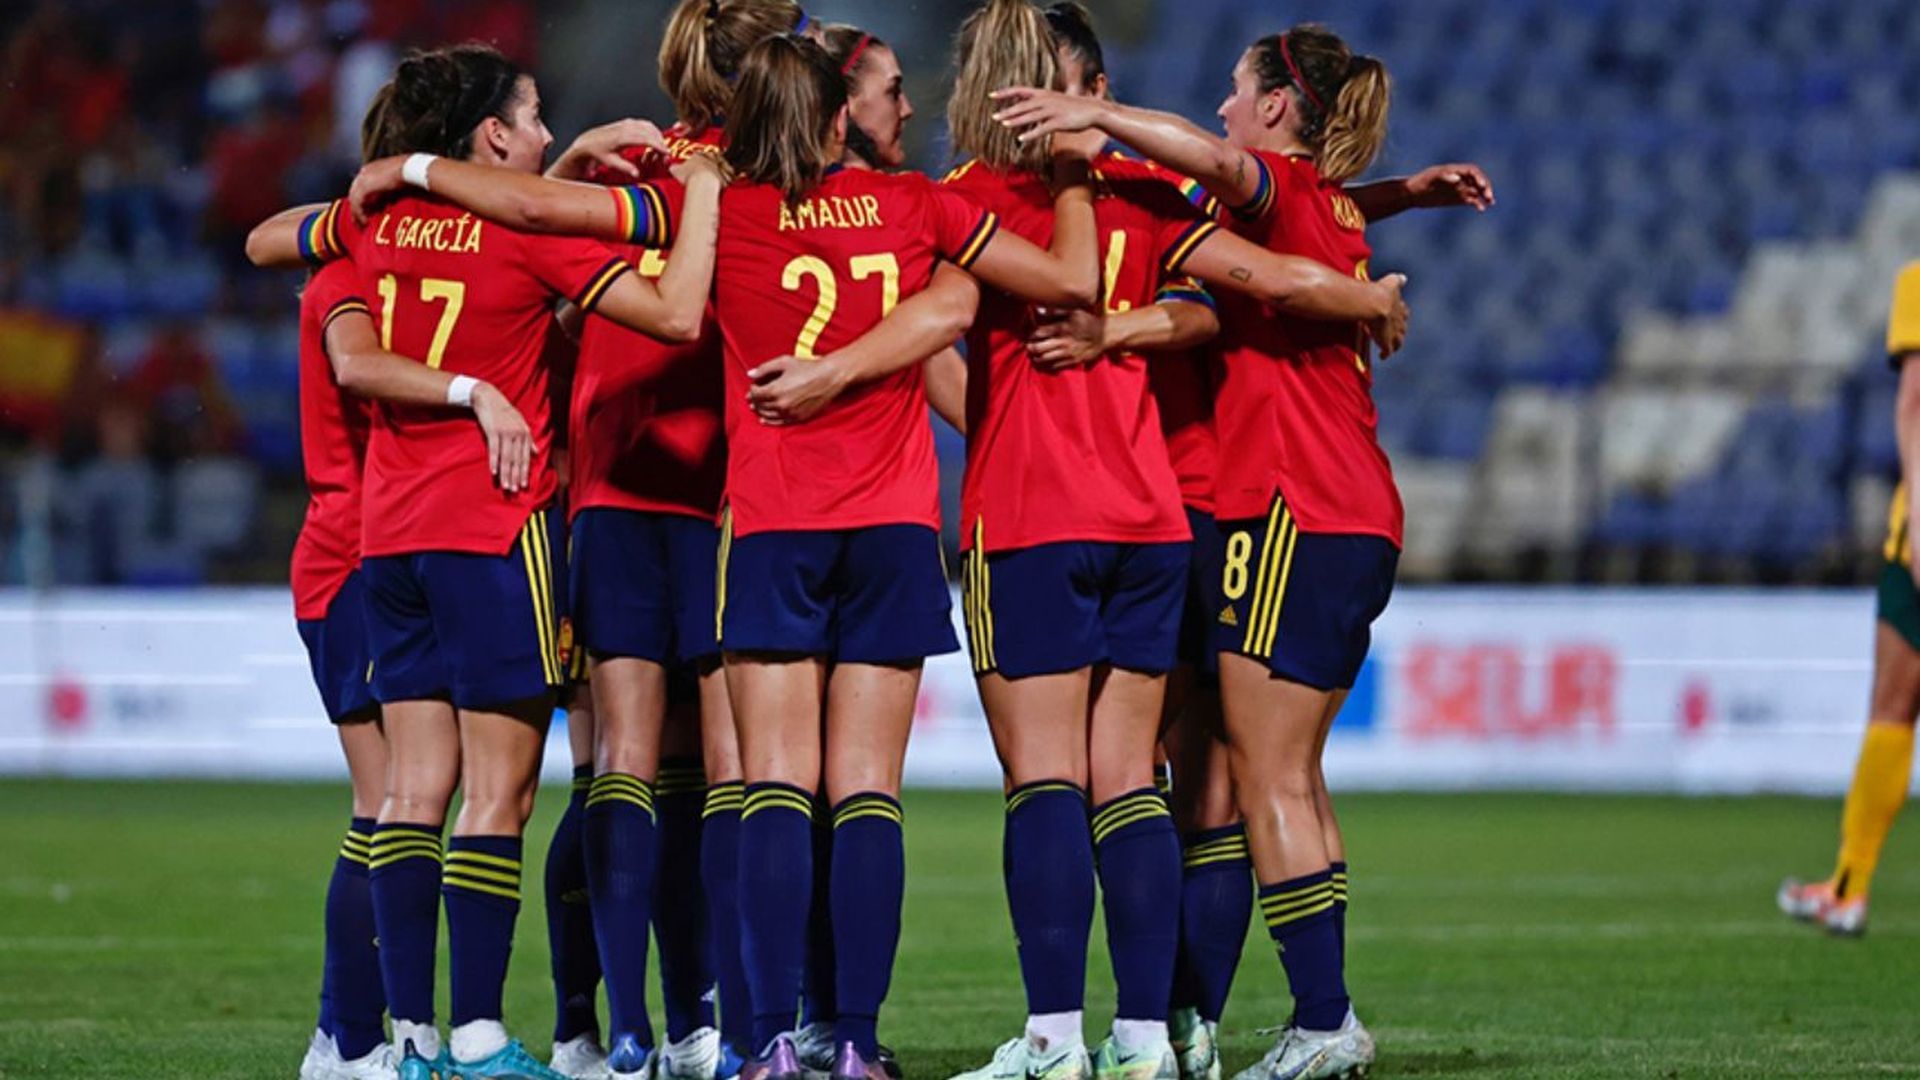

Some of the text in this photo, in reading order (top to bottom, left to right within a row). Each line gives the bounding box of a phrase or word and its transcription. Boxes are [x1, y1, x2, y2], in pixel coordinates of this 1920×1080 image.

[375, 211, 482, 254] L. GARCÍA
[778, 194, 883, 232] AMAIUR
[377, 273, 465, 369] 17
[781, 252, 900, 361] 27
[1222, 530, 1253, 600] 8
